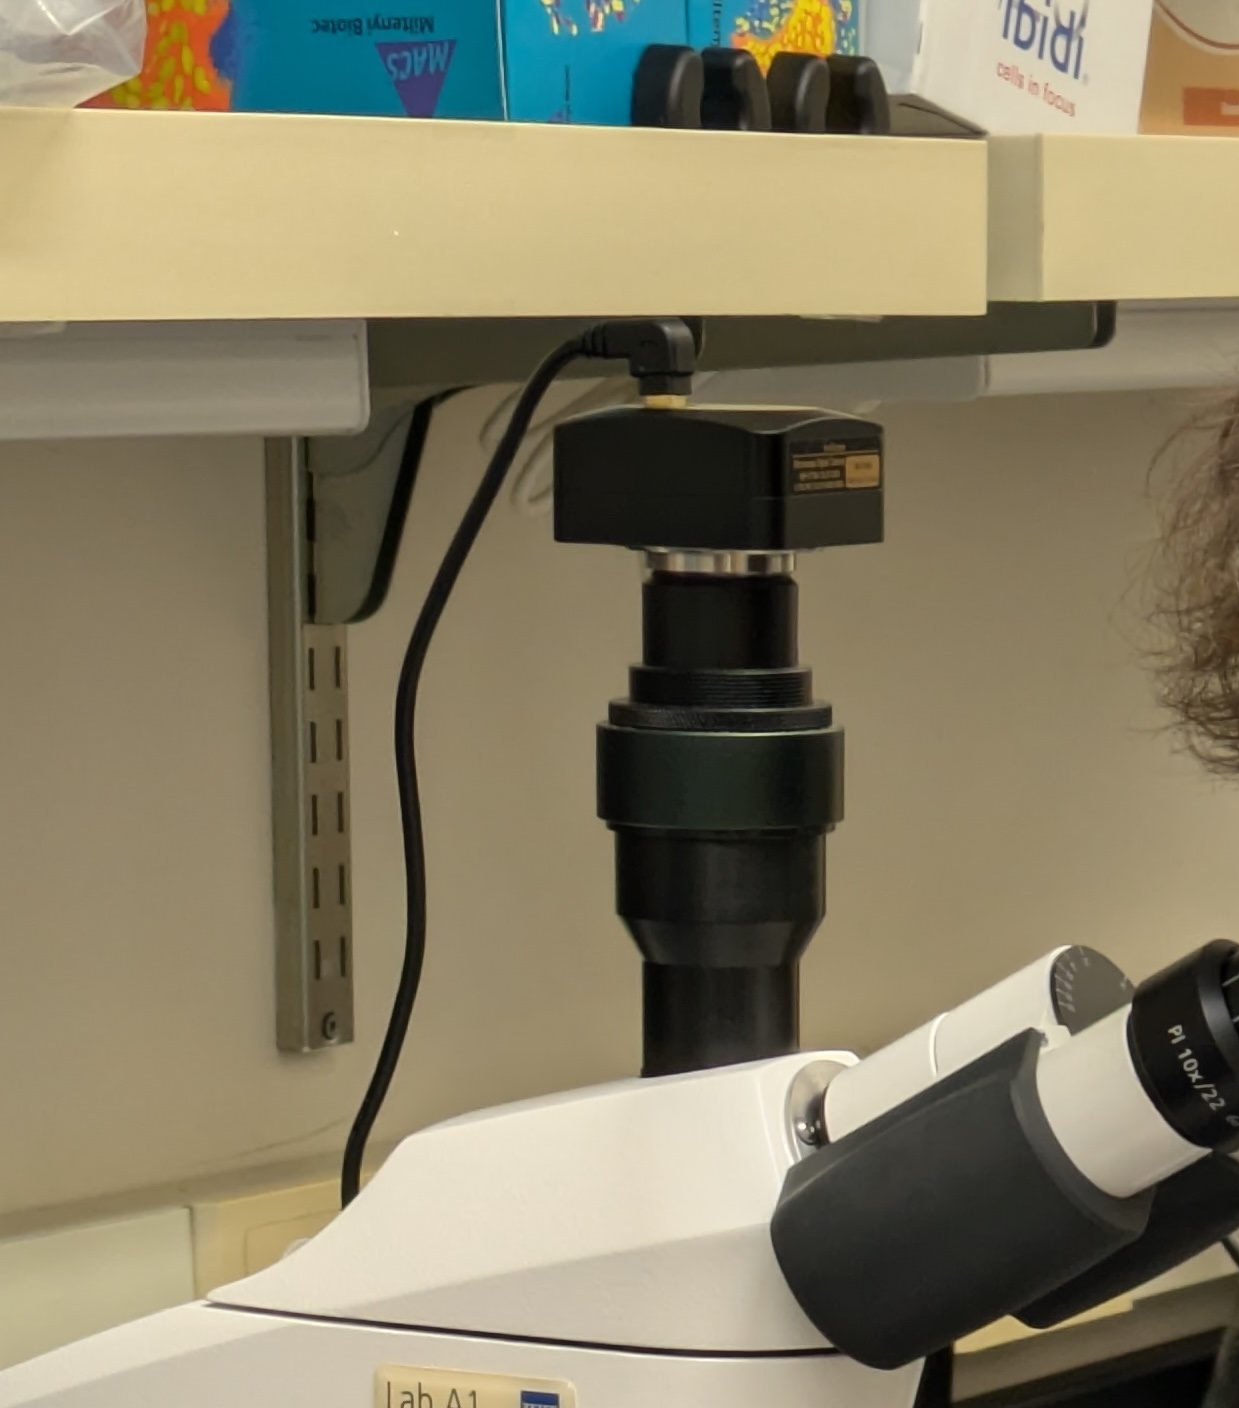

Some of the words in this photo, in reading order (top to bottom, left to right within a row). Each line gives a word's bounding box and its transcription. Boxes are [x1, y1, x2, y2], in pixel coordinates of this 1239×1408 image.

[311, 16, 364, 36] Biotec
[367, 13, 435, 35] Miltenyi
[385, 41, 450, 81] MACS
[996, 62, 1025, 89] cells
[1028, 74, 1040, 96] in
[1043, 82, 1076, 118] focus
[1177, 1048, 1227, 1111] 10x/22
